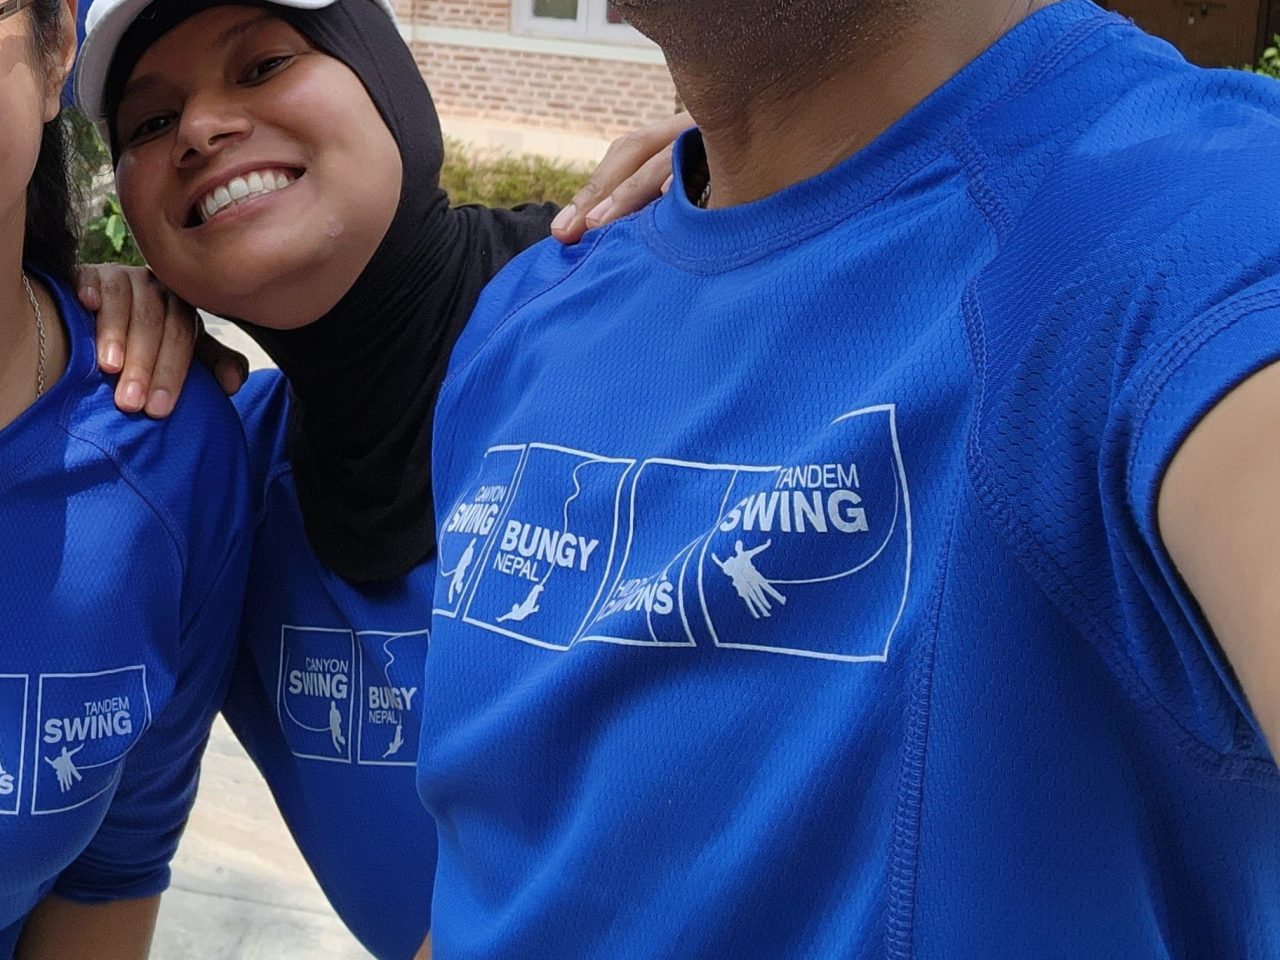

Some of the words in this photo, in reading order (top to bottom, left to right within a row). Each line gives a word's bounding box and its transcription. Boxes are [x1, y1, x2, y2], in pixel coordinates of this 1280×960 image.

[775, 463, 860, 489] TANDEM
[447, 503, 499, 535] SWING
[720, 490, 869, 533] SWING
[500, 520, 599, 572] BUNGY
[493, 551, 541, 582] NEPAL
[305, 657, 349, 673] CANYON
[289, 670, 348, 699] SWING
[84, 696, 130, 716] TANDEM
[368, 710, 398, 724] NEPAL
[43, 710, 133, 744] SWING
